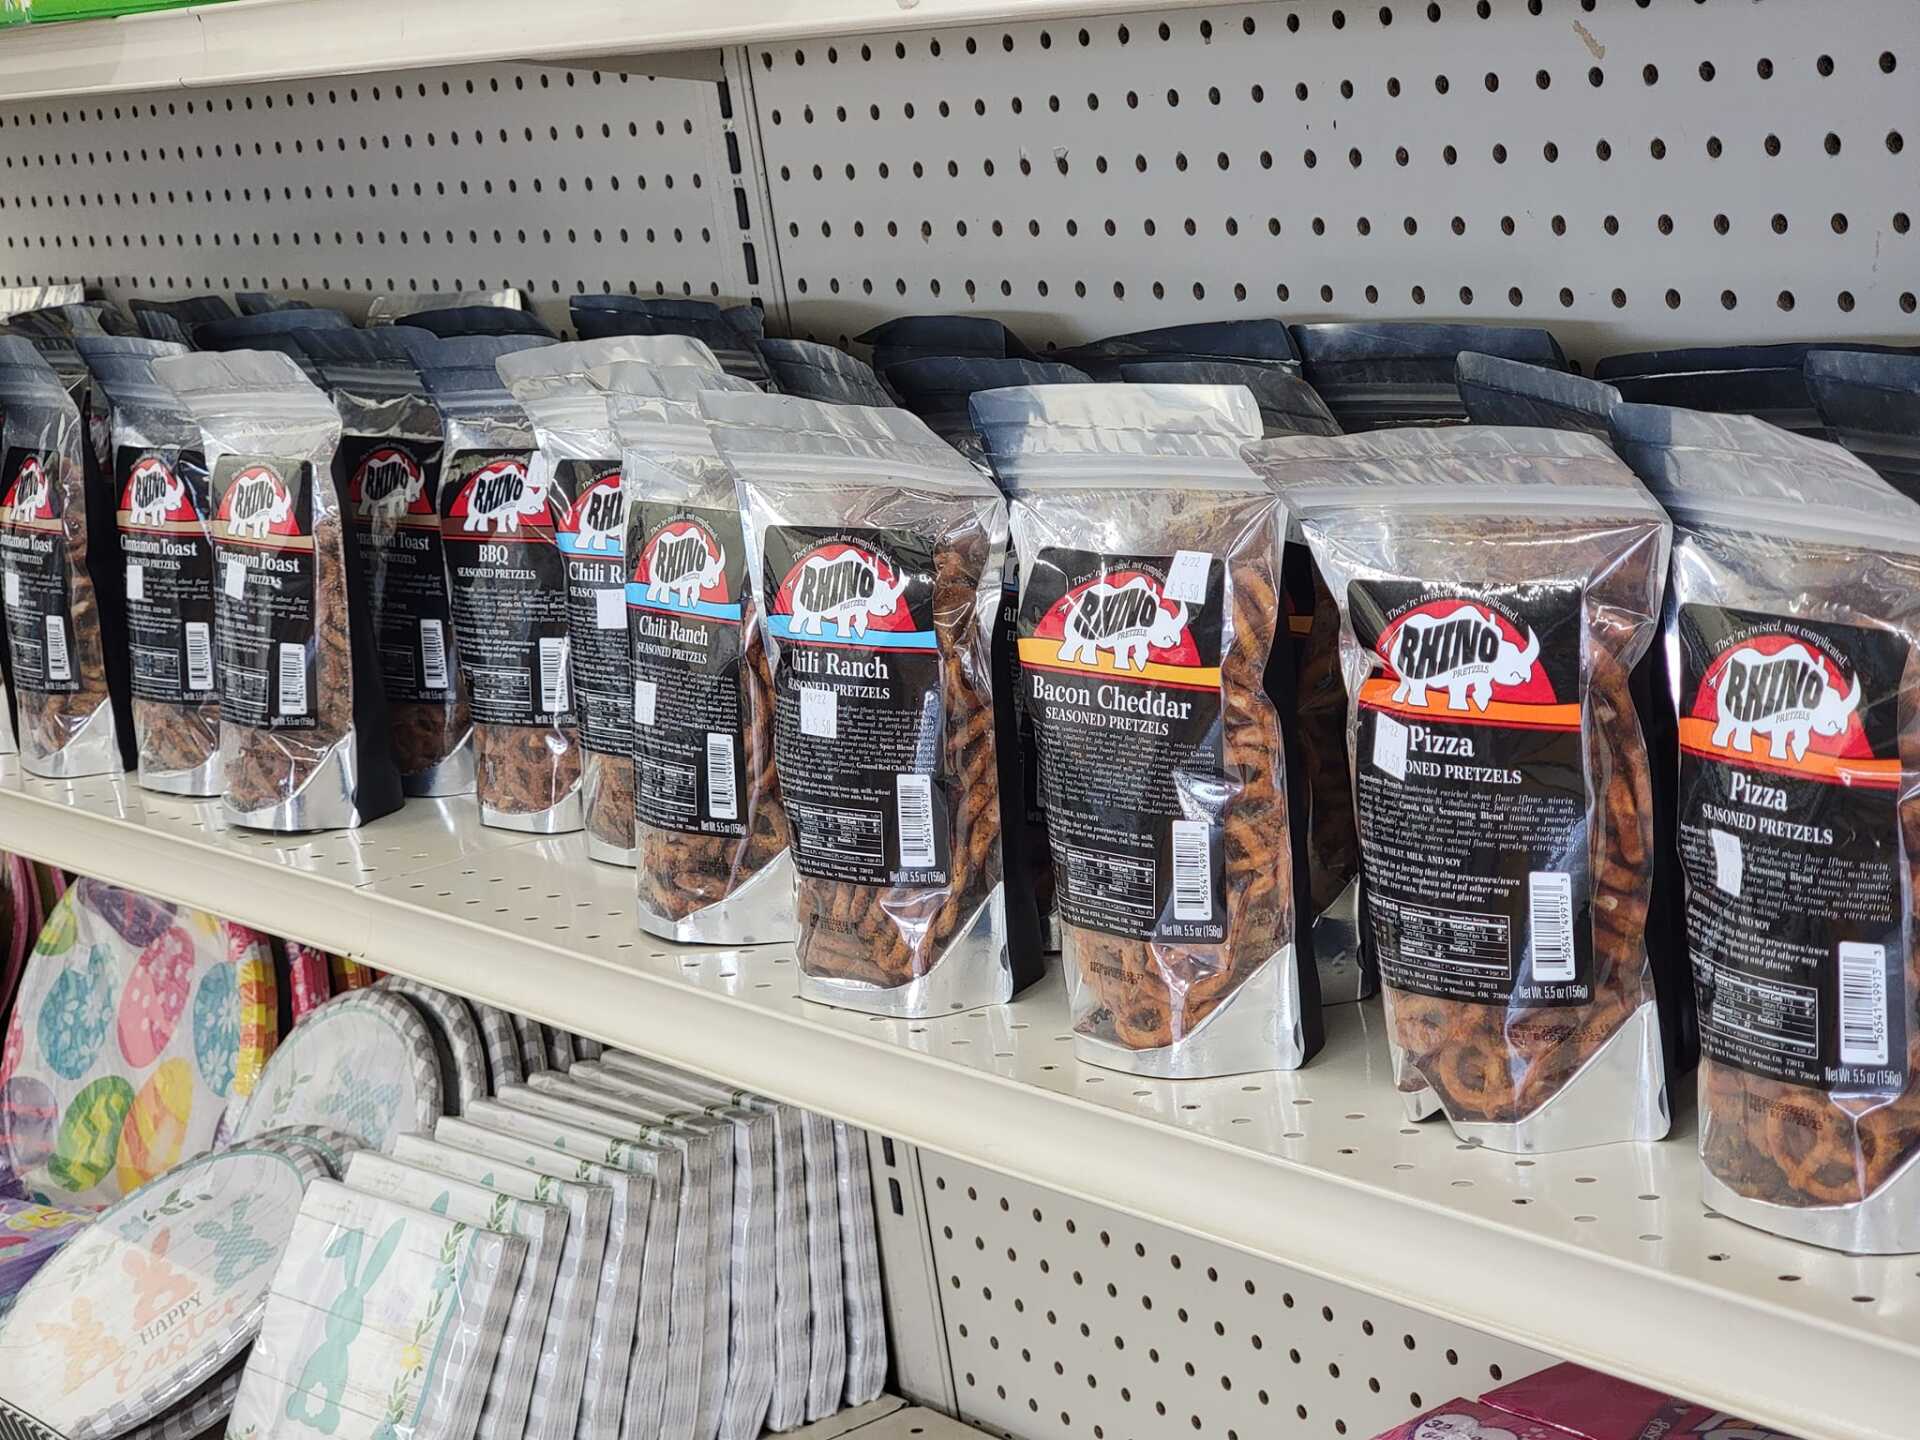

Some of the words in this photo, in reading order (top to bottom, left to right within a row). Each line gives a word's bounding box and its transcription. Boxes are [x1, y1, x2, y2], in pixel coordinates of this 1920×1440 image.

[135, 471, 167, 508] RHINO
[235, 481, 274, 519] RHINO
[473, 473, 524, 514] RHINO
[160, 539, 197, 556] Toast
[399, 531, 430, 551] Toast
[261, 552, 299, 573] Toast
[479, 545, 509, 565] BBQ
[655, 537, 707, 583] RHINO
[457, 567, 494, 578] SEASONED
[495, 569, 536, 580] PRETZELS
[569, 562, 605, 582] Chili
[800, 560, 874, 612] RHINO
[1073, 588, 1157, 640] RHINO
[1386, 597, 1419, 621] They're
[639, 615, 667, 639] Chili
[670, 621, 709, 647] Ranch
[1714, 628, 1746, 653] They're
[1748, 620, 1783, 634] twisted,
[1784, 622, 1801, 635] not
[637, 642, 671, 658] SEASONED
[672, 648, 708, 665] PRETZELS
[1397, 618, 1500, 680] RHINO
[825, 652, 889, 679] Ranch
[1452, 665, 1490, 679] PRETZELS
[832, 683, 890, 700] PRETZELS
[1032, 674, 1090, 705] Bacon
[1097, 685, 1192, 720] Cheddar
[1725, 658, 1824, 722] RHINO
[1045, 706, 1106, 727] SEASONED
[1109, 715, 1169, 735] PRETZELS
[1775, 711, 1811, 724] PRETZELS
[1409, 725, 1475, 758] Pizza
[1405, 760, 1441, 777] ONED
[1445, 764, 1522, 785] PRETZELS
[1495, 793, 1515, 803] flour
[1730, 771, 1788, 812] Pizza
[1439, 807, 1477, 820] Seasoning
[1480, 811, 1504, 820] Blend
[1702, 803, 1756, 831] SEASONED
[1759, 816, 1833, 845] PRETZELS
[1427, 855, 1444, 864] AND
[1445, 858, 1461, 867] SOY
[1782, 849, 1801, 859] wheat
[1804, 853, 1824, 863] flour
[910, 871, 920, 882] 5.5
[1440, 871, 1456, 880] also
[1750, 863, 1786, 881] Seasoning
[1790, 872, 1813, 884] Blend
[1857, 880, 1893, 893] powder,
[1440, 881, 1451, 889] oil
[1452, 883, 1468, 891] and
[1470, 884, 1492, 893] other
[1493, 888, 1509, 897] soy
[1441, 891, 1456, 899] and
[1457, 892, 1485, 903] gluten.
[1560, 894, 1569, 926] 49913
[1808, 907, 1841, 920] parsley,
[1844, 912, 1868, 921] citric
[1161, 924, 1172, 936] Net
[1173, 924, 1183, 936] Wt.
[1184, 925, 1194, 936] 5.5
[1203, 924, 1223, 938] (156g)
[1738, 915, 1753, 926] AND
[1755, 919, 1770, 931] SOY
[1562, 929, 1571, 960] 56541
[1766, 938, 1829, 956] processes/uses
[1761, 947, 1777, 958] and
[1777, 950, 1799, 963] other
[1801, 956, 1818, 968] soy
[1519, 986, 1531, 998] Net
[1532, 986, 1543, 999] Wt.
[1544, 986, 1555, 998] 5.5
[1556, 989, 1564, 998] oz
[1565, 985, 1588, 1000] (156g)
[1872, 968, 1883, 1003] 49913
[1873, 1007, 1884, 1041] 56541
[1825, 1066, 1837, 1082] Net
[1837, 1067, 1851, 1082] Wt.
[1853, 1069, 1866, 1083] 5.5
[1867, 1073, 1876, 1084] oz
[1877, 1071, 1902, 1088] (156g)
[139, 1291, 203, 1345] HAPPY
[113, 1294, 242, 1394] Easter
